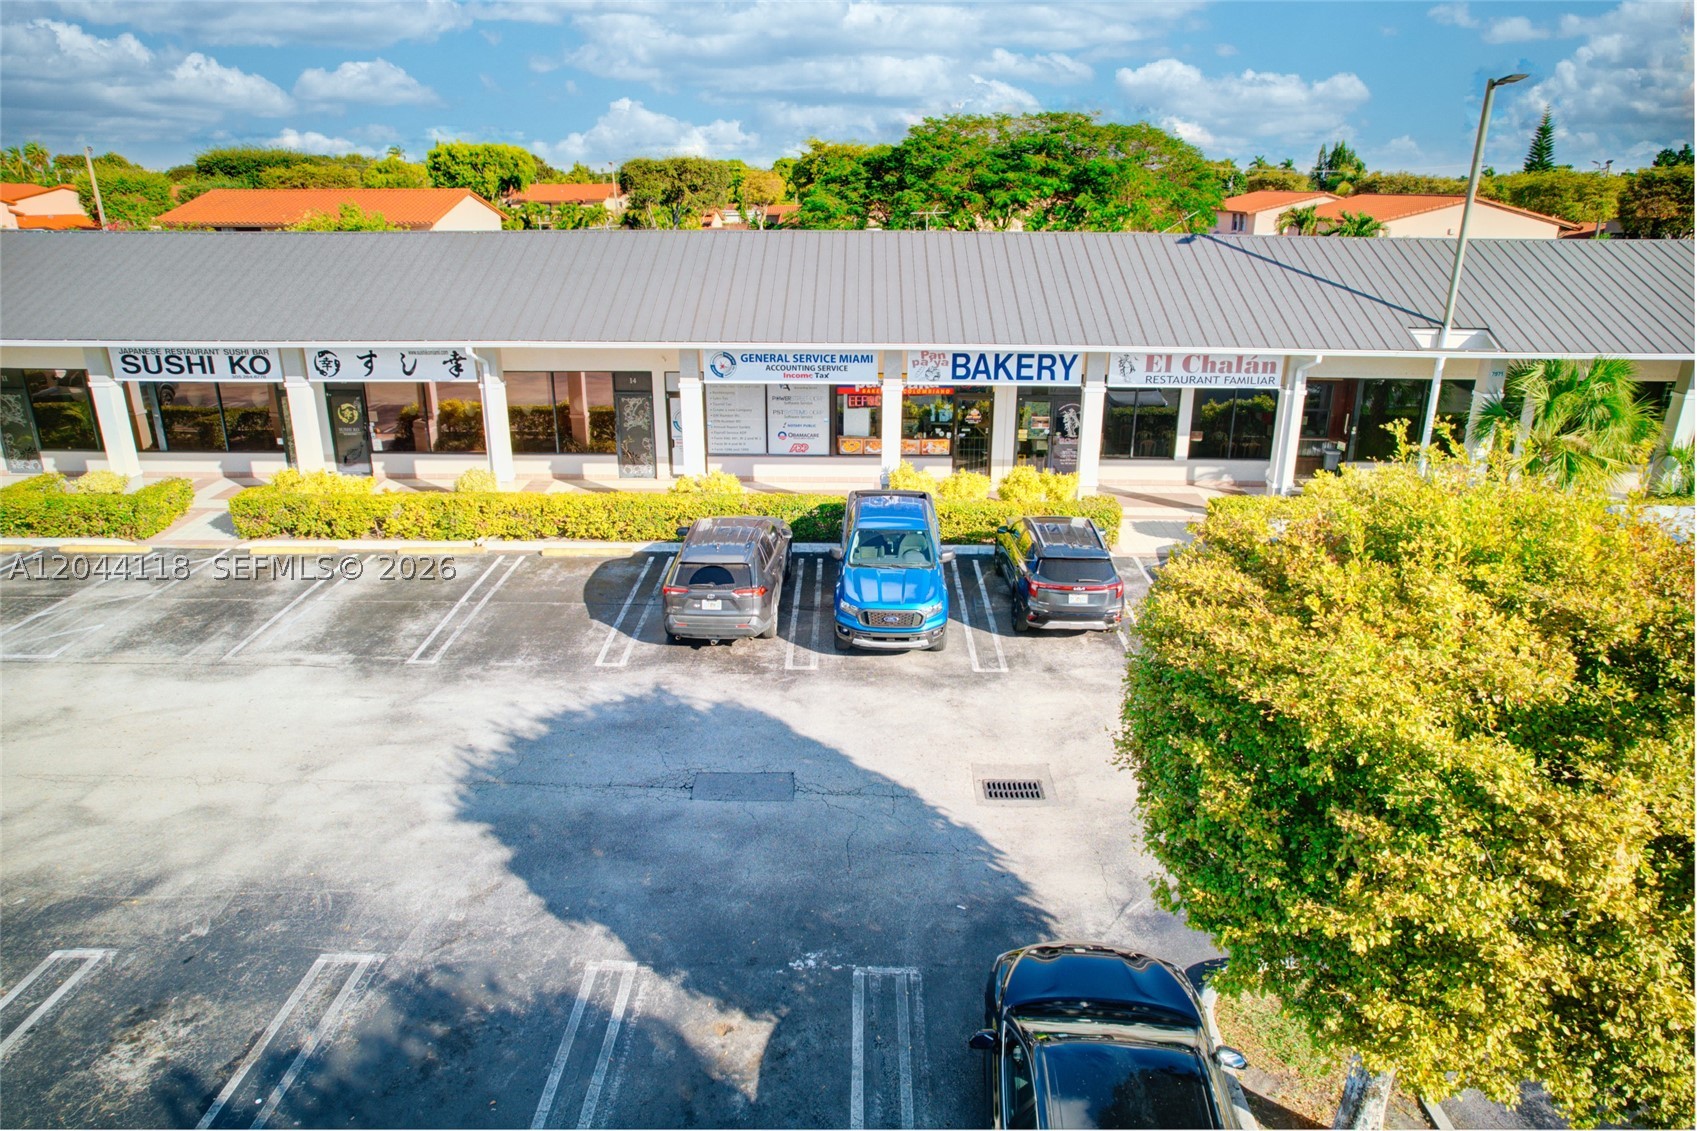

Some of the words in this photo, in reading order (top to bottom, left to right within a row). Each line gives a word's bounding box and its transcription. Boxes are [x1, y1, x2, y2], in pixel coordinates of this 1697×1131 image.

[740, 354, 788, 363] GENERAL
[793, 354, 840, 364] SERVICE
[843, 354, 874, 364] MIAMI
[920, 350, 946, 360] Pan
[120, 354, 216, 374] SUSHI
[228, 355, 272, 375] KO
[951, 352, 1079, 381] BAKERY
[1144, 354, 1173, 373] El
[1182, 354, 1277, 374] Chalán
[1145, 375, 1220, 384] RESTAURANT
[1224, 376, 1276, 385] FAMILIAR
[789, 443, 809, 452] ADP
